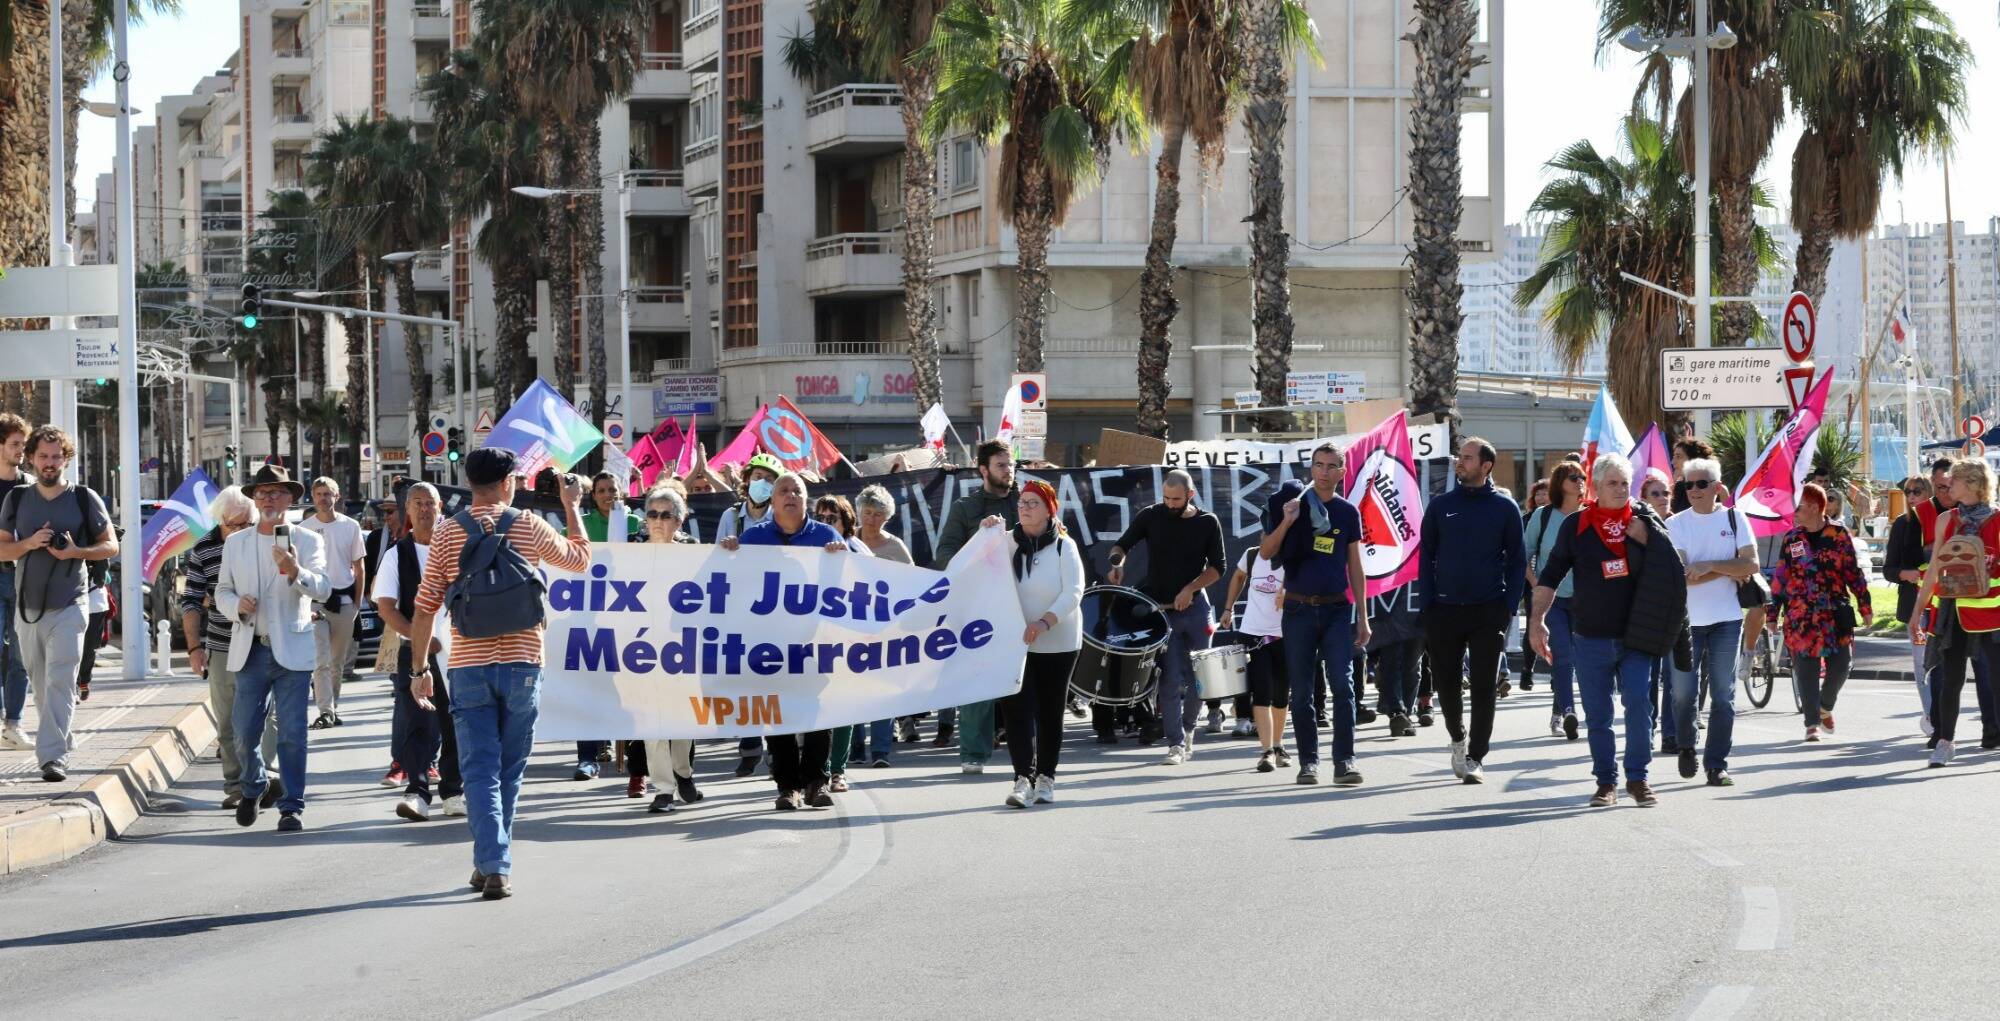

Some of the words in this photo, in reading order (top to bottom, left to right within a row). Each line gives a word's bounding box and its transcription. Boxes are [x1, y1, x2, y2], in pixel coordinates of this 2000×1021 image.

[1690, 361, 1716, 372] gare
[1719, 357, 1771, 369] maritime
[795, 376, 839, 396] TONGA
[1669, 376, 1706, 384] serrez
[1712, 374, 1720, 383] à
[1725, 374, 1762, 383] droite
[1671, 389, 1699, 401] 700
[1373, 468, 1416, 542] olidaires
[1605, 560, 1625, 570] PCF
[537, 564, 647, 613] aix
[668, 572, 731, 615] et
[564, 614, 994, 676] Méditerranée
[689, 694, 783, 726] VPJM
